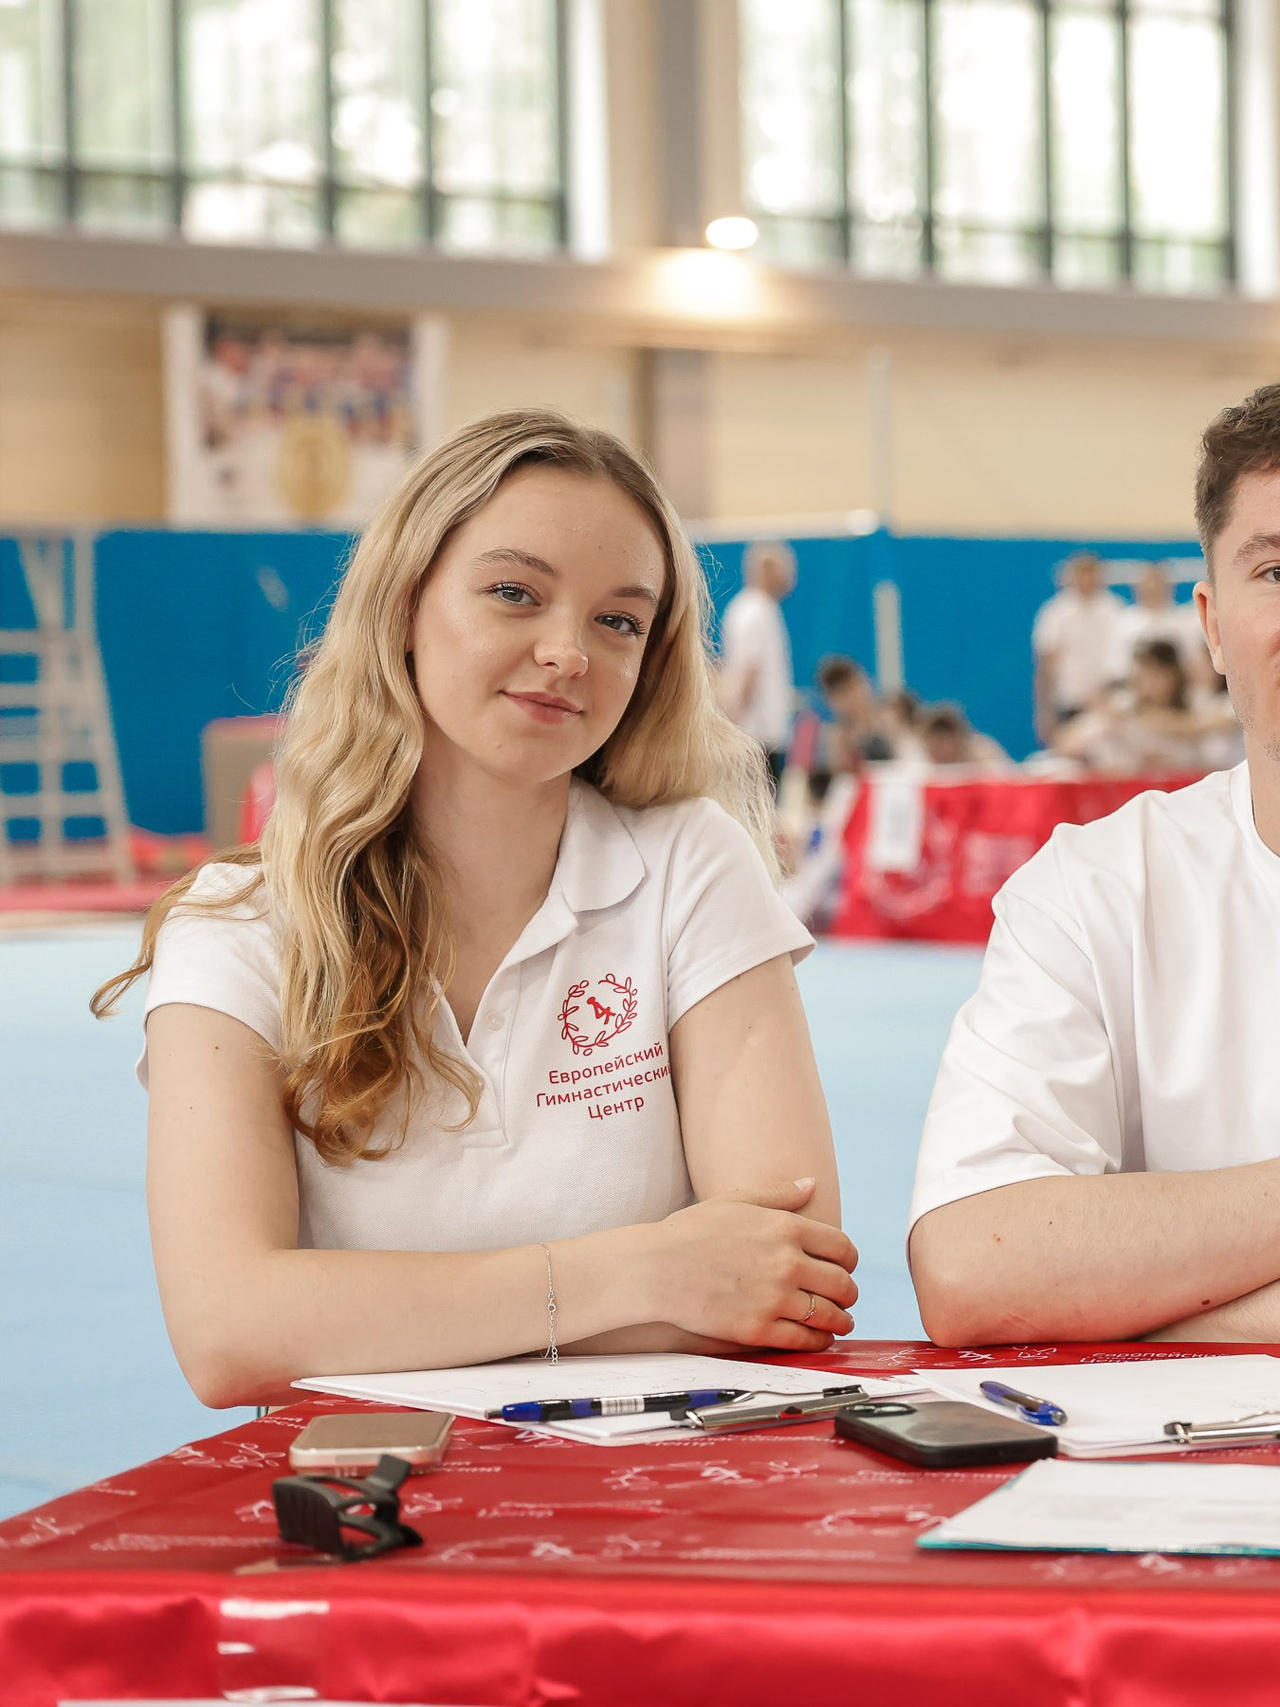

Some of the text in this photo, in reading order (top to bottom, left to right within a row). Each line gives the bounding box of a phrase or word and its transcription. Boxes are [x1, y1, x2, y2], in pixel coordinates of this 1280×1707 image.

[549, 1042, 664, 1084] Европейский
[588, 1096, 645, 1120] Центр
[1092, 1351, 1230, 1359] Европейски
